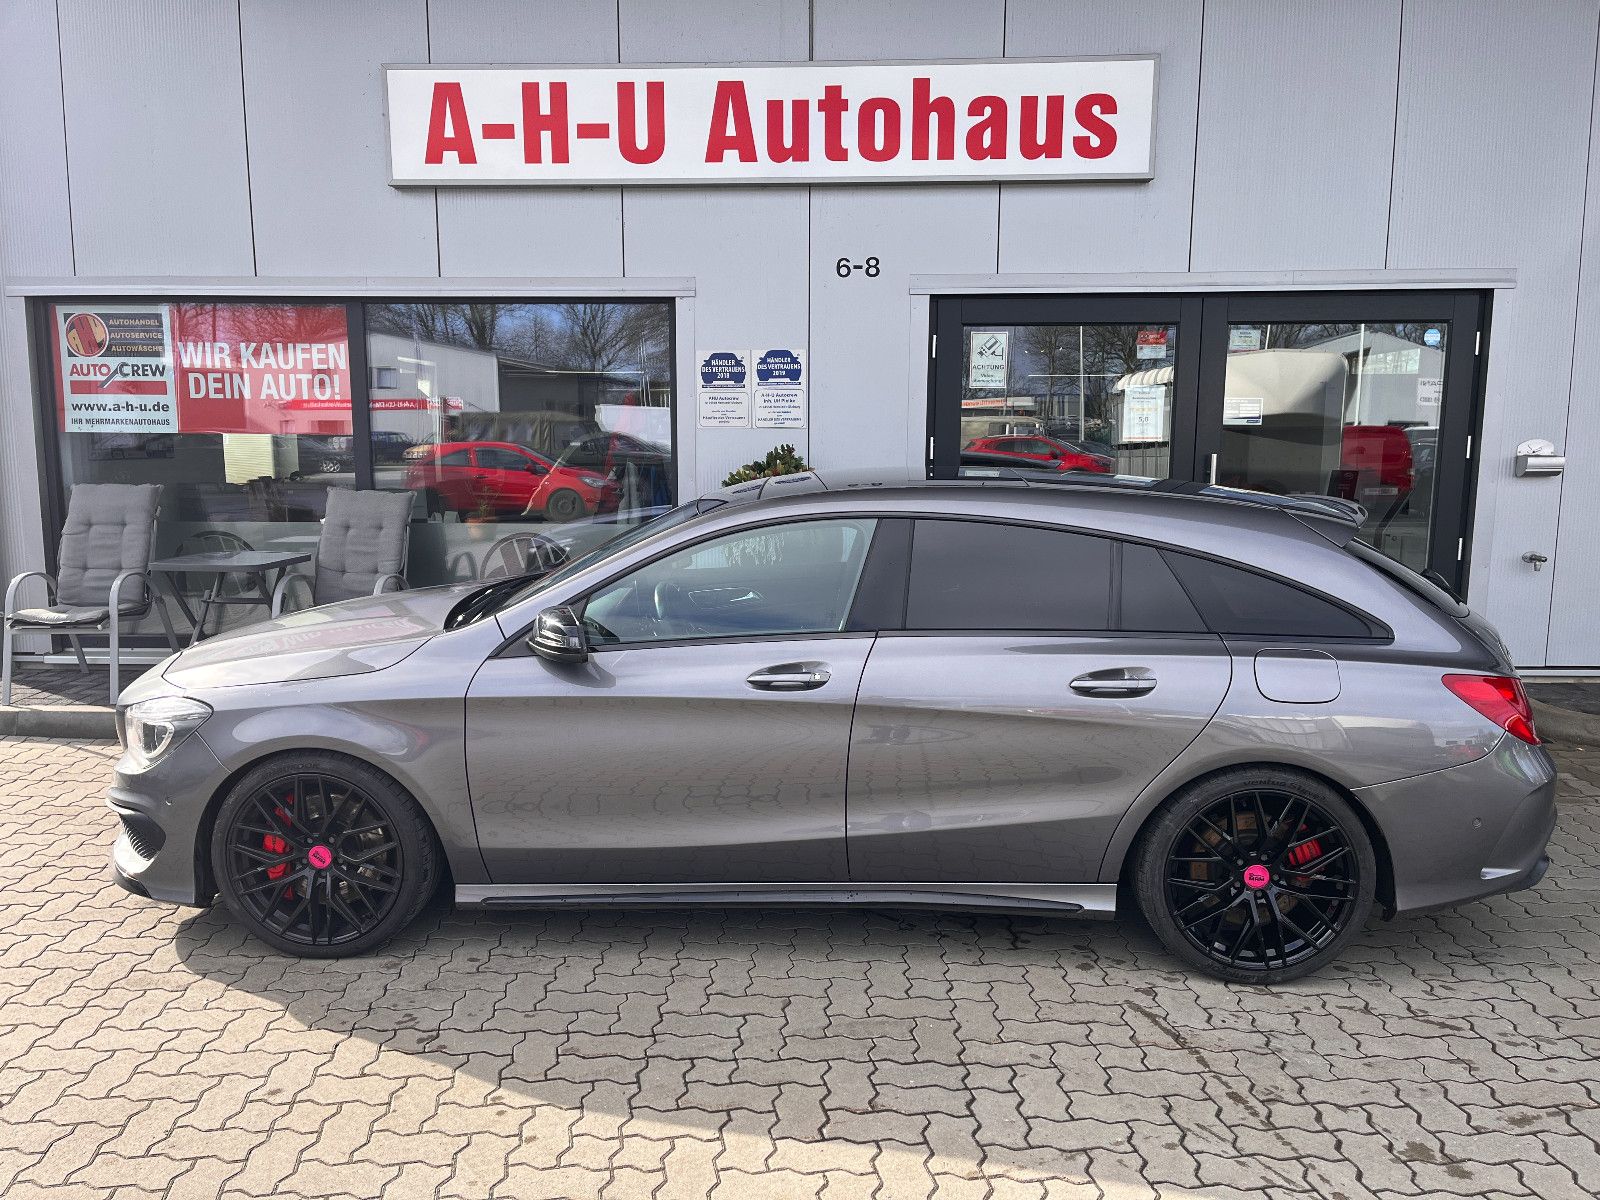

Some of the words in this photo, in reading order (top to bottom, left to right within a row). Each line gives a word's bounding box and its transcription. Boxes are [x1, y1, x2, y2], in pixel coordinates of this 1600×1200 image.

[425, 81, 666, 165] A-H-U
[704, 77, 1119, 163] Autohaus
[835, 256, 880, 279] 6-8
[108, 318, 160, 327] AUTOHANDEL
[110, 331, 163, 340] AUTOSERVICE
[111, 344, 164, 352] AUTOWÄSCHE
[177, 341, 232, 369] WIR
[240, 342, 347, 370] KAUFEN
[188, 372, 250, 400] DEIN
[259, 373, 341, 401] AUTO!
[71, 401, 170, 412] www.a-h-u.de
[71, 417, 83, 425] IHR
[85, 418, 170, 426] MEHRMARKENAUTOHAUS
